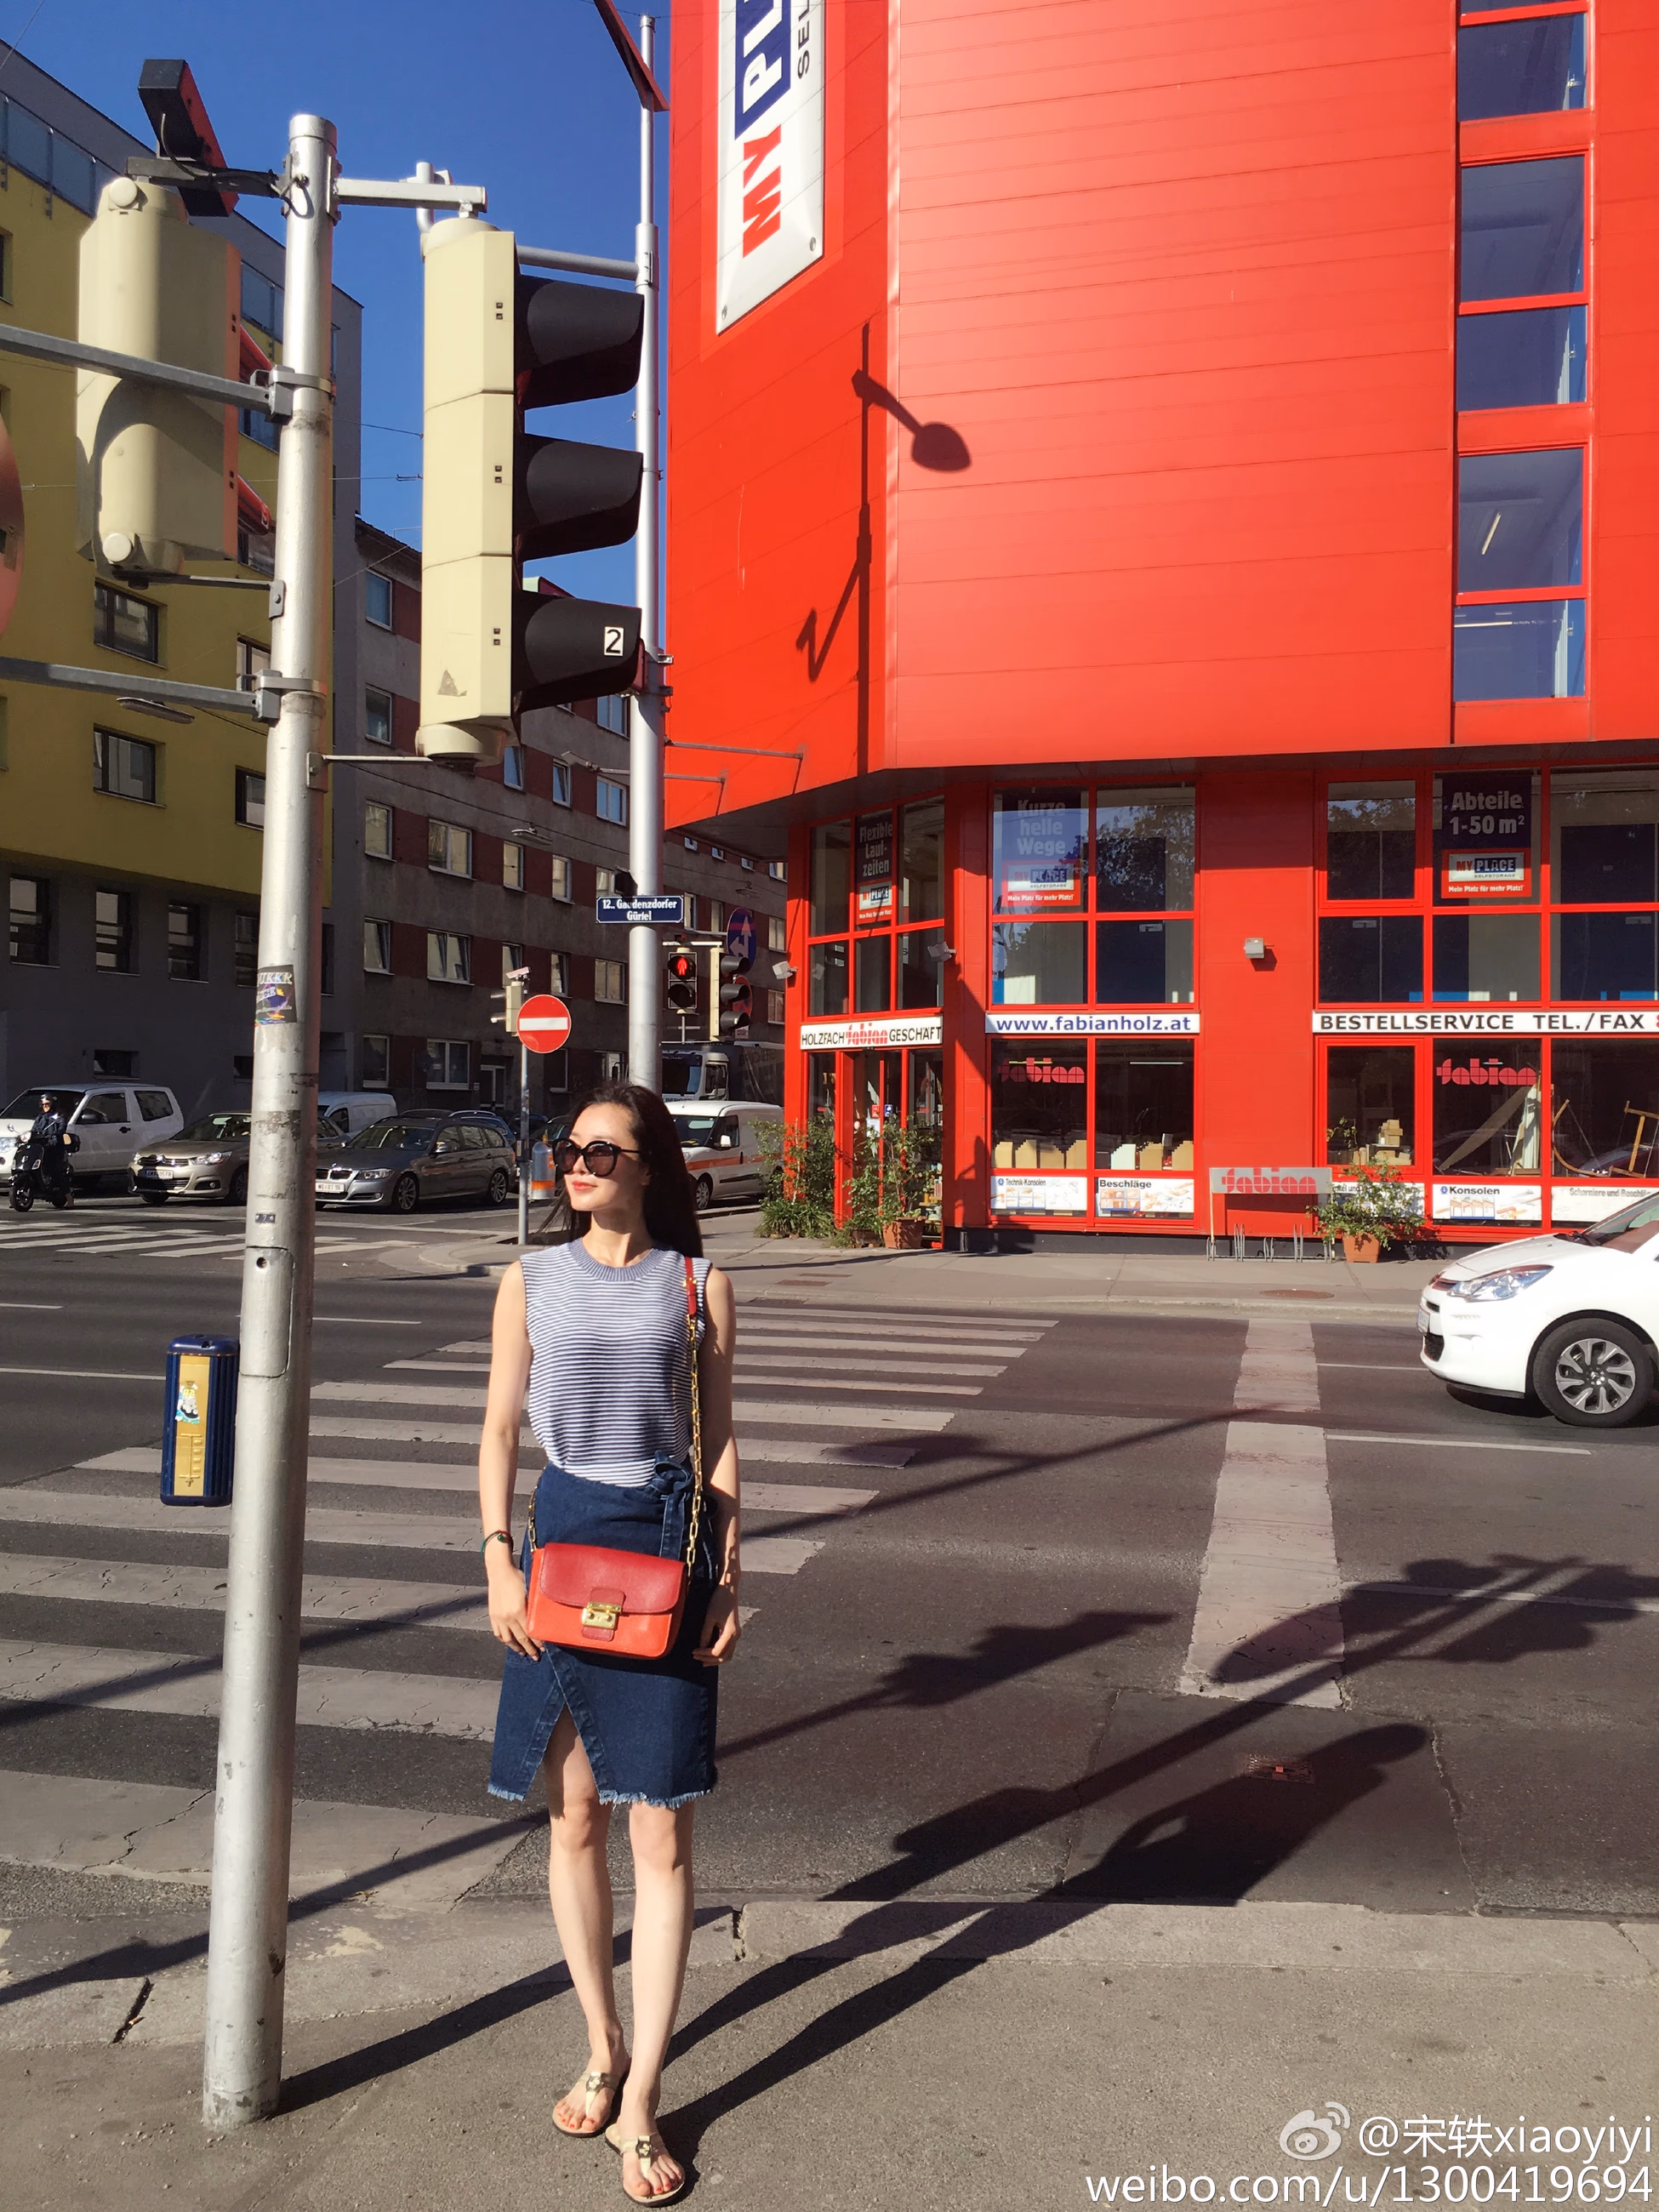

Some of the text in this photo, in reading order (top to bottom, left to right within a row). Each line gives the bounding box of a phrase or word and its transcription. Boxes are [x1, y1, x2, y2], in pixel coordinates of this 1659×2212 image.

[743, 0, 783, 259] MY PL
[606, 629, 621, 653] 2
[1018, 799, 1066, 818] Kurze
[1451, 790, 1523, 812] Abteile
[859, 821, 892, 843] Flexible
[1450, 815, 1495, 835] 1-50
[1017, 837, 1066, 857] Wege
[863, 859, 890, 877] zeiten
[1457, 858, 1515, 872] MY PLACE
[1032, 869, 1066, 882] PLACE
[627, 910, 652, 921] Gürtel
[996, 1016, 1191, 1031] www.fabianholz.at
[1320, 1014, 1514, 1030] BESTELLSERVICE
[801, 1023, 942, 1046] HOLZFACH fabian GESCHÄFT
[997, 1058, 1085, 1083] fabian
[1436, 1058, 1536, 1086] fabian
[1099, 1179, 1152, 1189] Beschläge
[1221, 1168, 1317, 1193] fabian
[1449, 1186, 1501, 1195] Konsolen
